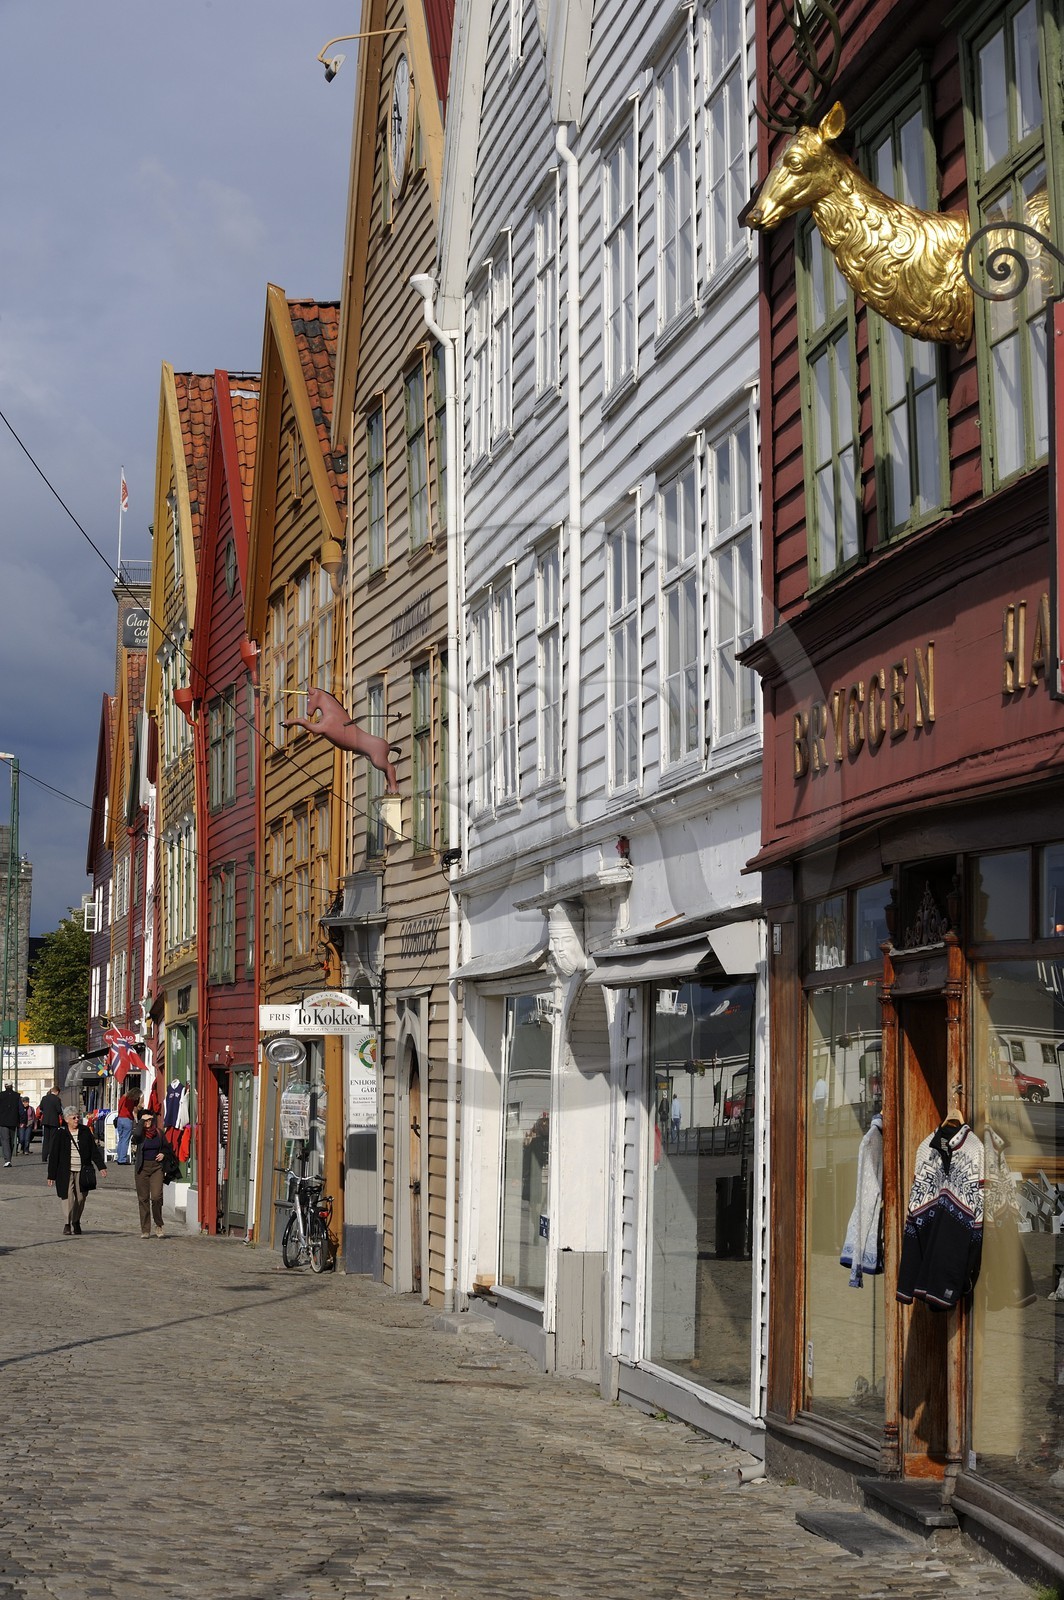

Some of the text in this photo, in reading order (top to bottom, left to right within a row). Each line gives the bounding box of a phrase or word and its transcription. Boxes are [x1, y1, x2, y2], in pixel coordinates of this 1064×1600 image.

[794, 640, 935, 779] BRYGGEN
[307, 993, 353, 1004] RESTAURANT
[295, 1008, 364, 1025] To Kokker
